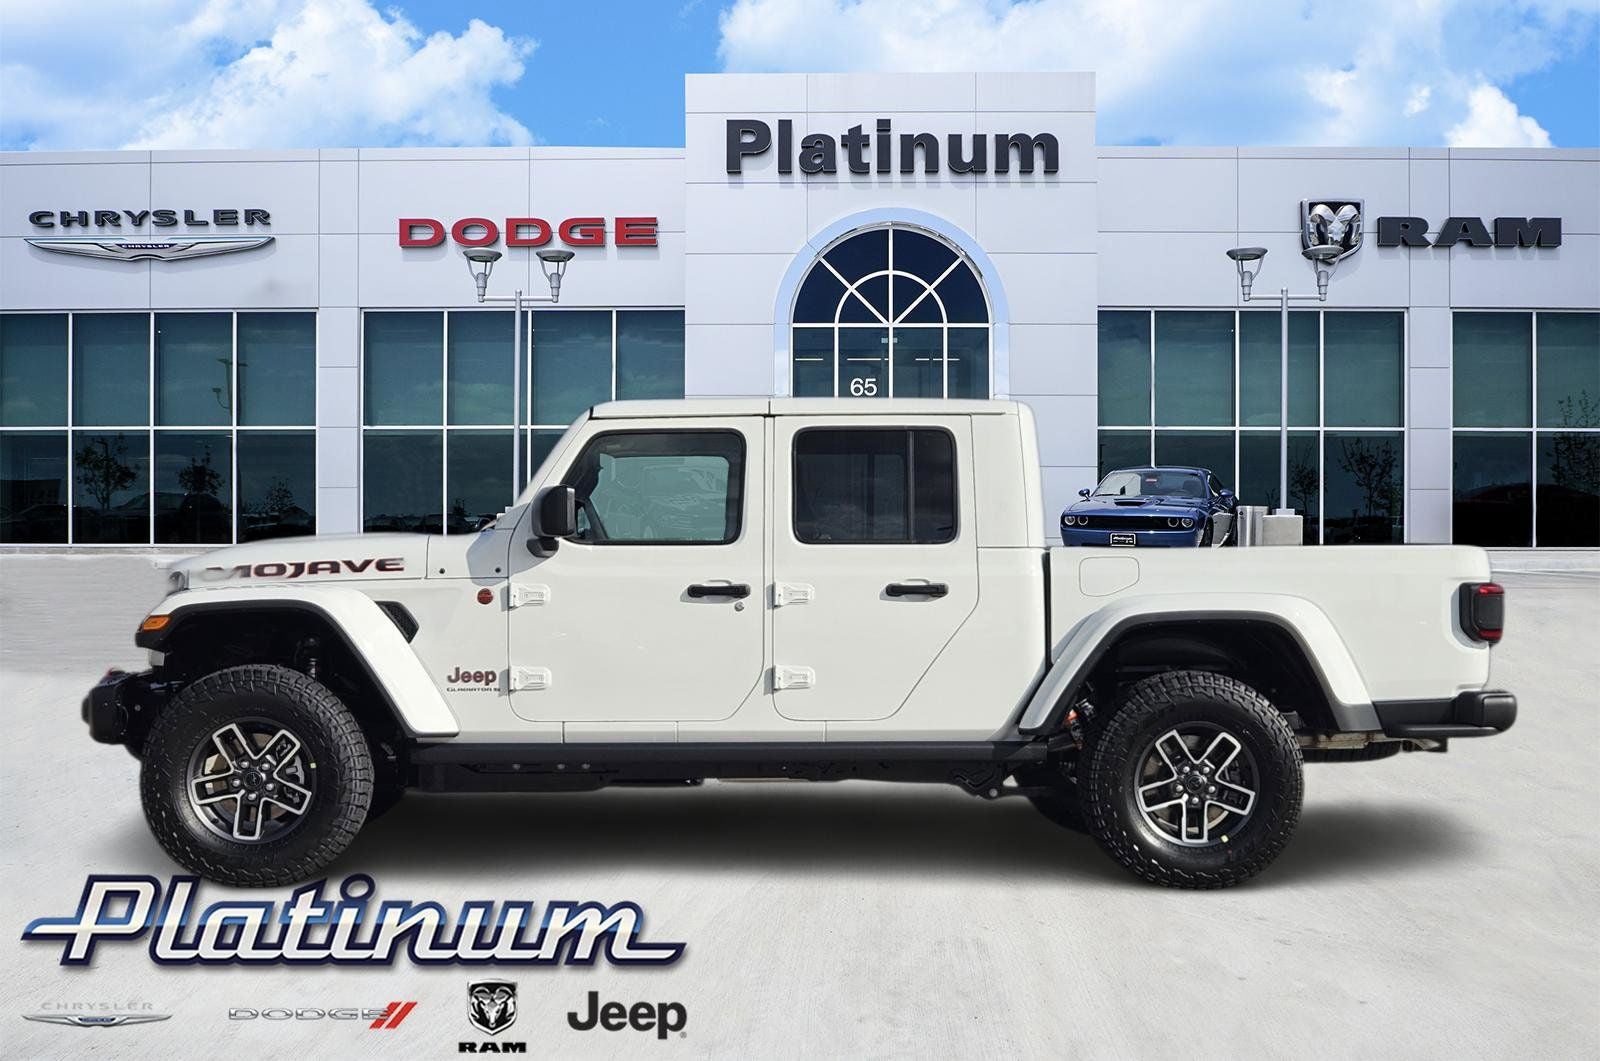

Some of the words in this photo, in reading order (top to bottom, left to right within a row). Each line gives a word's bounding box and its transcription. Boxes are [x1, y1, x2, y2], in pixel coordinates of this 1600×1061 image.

[726, 119, 1060, 175] Platinum
[29, 208, 271, 228] CHRYSLER
[398, 216, 660, 248] DODGE
[1376, 216, 1563, 248] RAM
[850, 378, 878, 397] 65
[446, 666, 497, 686] Jeep
